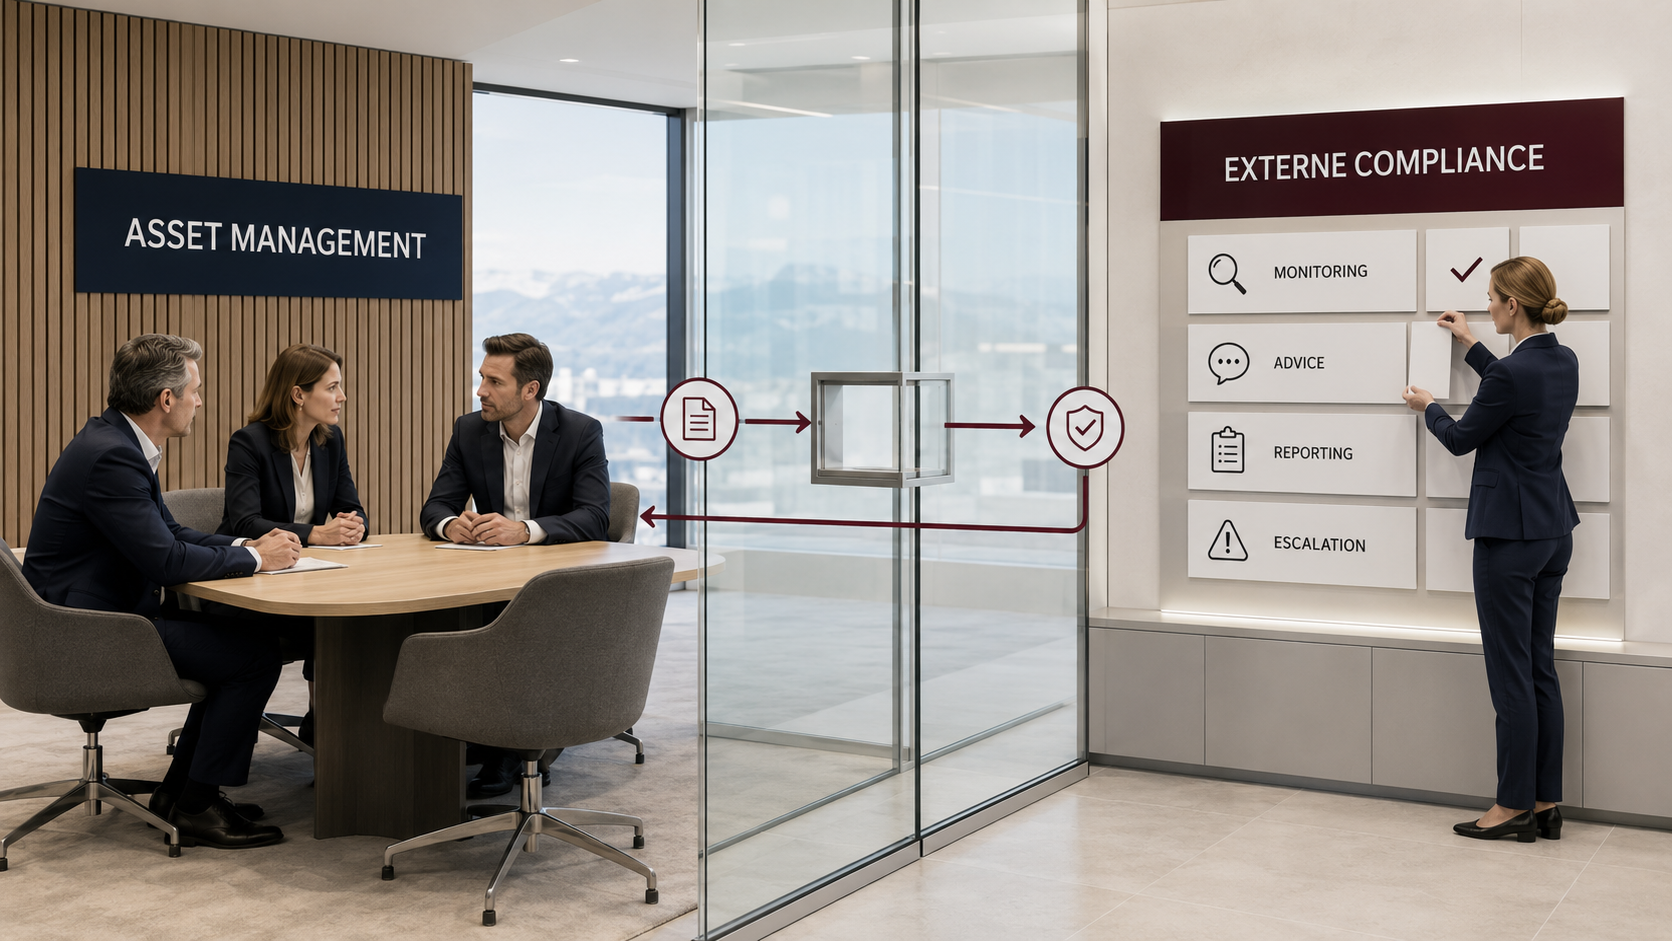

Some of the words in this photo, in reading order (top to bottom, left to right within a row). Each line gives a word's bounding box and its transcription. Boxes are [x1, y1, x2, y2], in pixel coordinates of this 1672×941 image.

[1225, 152, 1347, 182] EXTERNE
[1354, 143, 1545, 177] COMPLIANCE
[124, 217, 223, 251] ASSET
[231, 223, 427, 260] MANAGEMENT
[1273, 264, 1368, 280] MONITORING
[1273, 356, 1325, 370] ADVICE
[1273, 445, 1354, 461] REPORTING
[1273, 535, 1366, 553] ESCALATION
